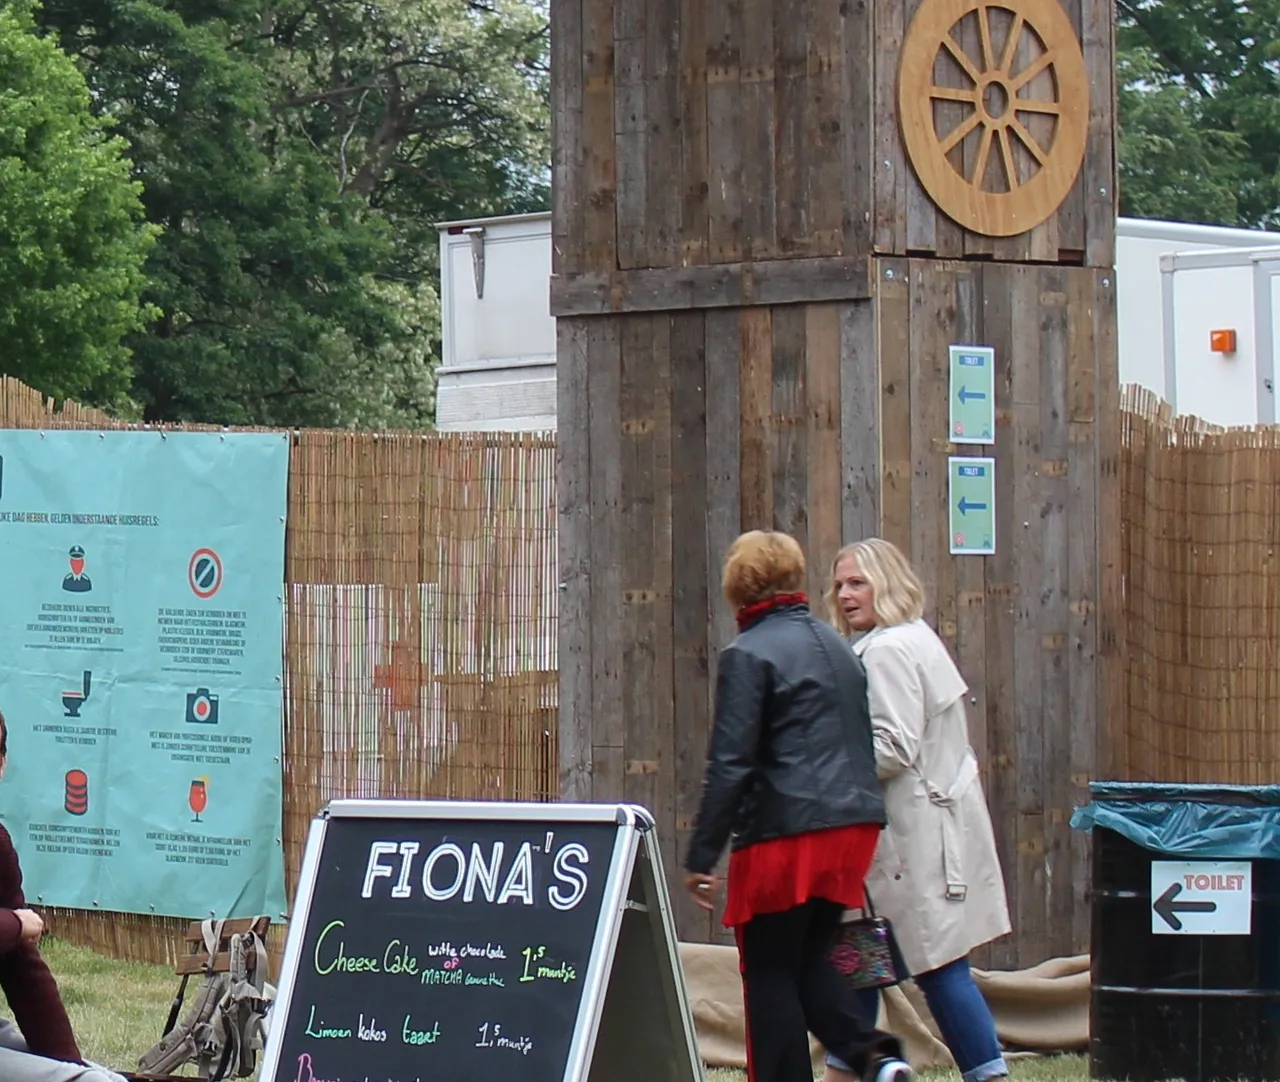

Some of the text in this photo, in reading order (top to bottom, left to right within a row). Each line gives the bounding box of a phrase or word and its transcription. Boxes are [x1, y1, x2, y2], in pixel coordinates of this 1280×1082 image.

[361, 831, 589, 911] FIONA'S
[1183, 874, 1245, 891] TOILET
[315, 920, 419, 975] Cheese Cake
[421, 968, 462, 985] MATCHA
